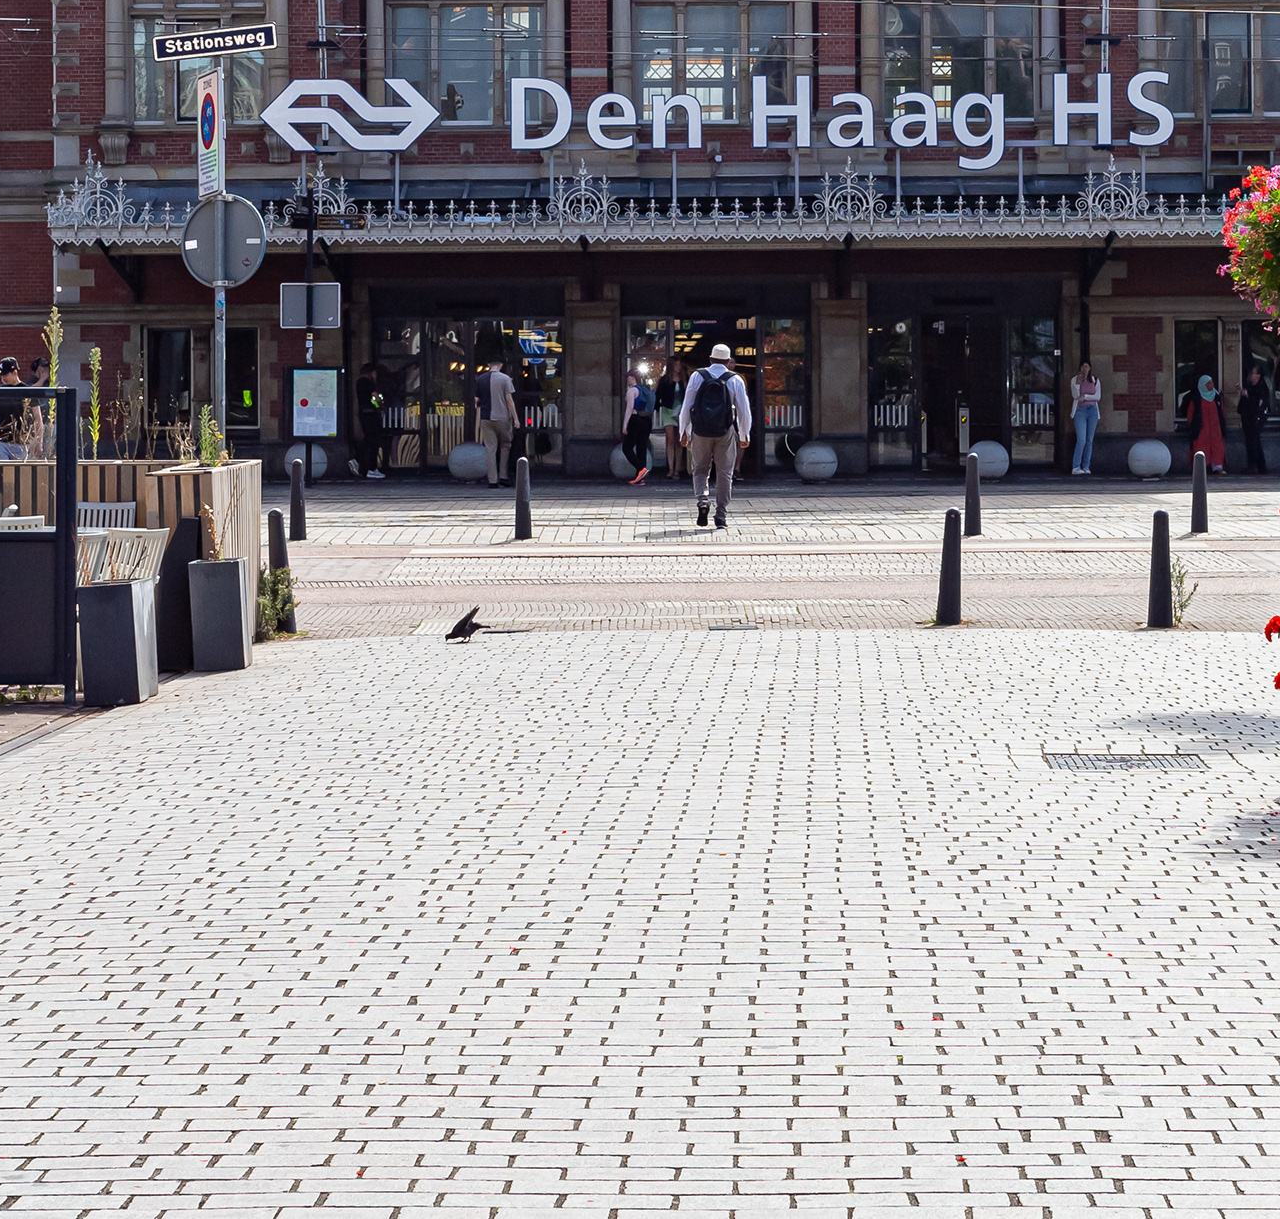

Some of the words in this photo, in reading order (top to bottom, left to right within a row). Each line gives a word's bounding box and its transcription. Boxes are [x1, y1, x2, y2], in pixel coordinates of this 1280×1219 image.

[165, 31, 266, 53] Stationsweg
[510, 76, 705, 151] Den
[751, 74, 1007, 171] Haag
[1052, 70, 1177, 148] HS
